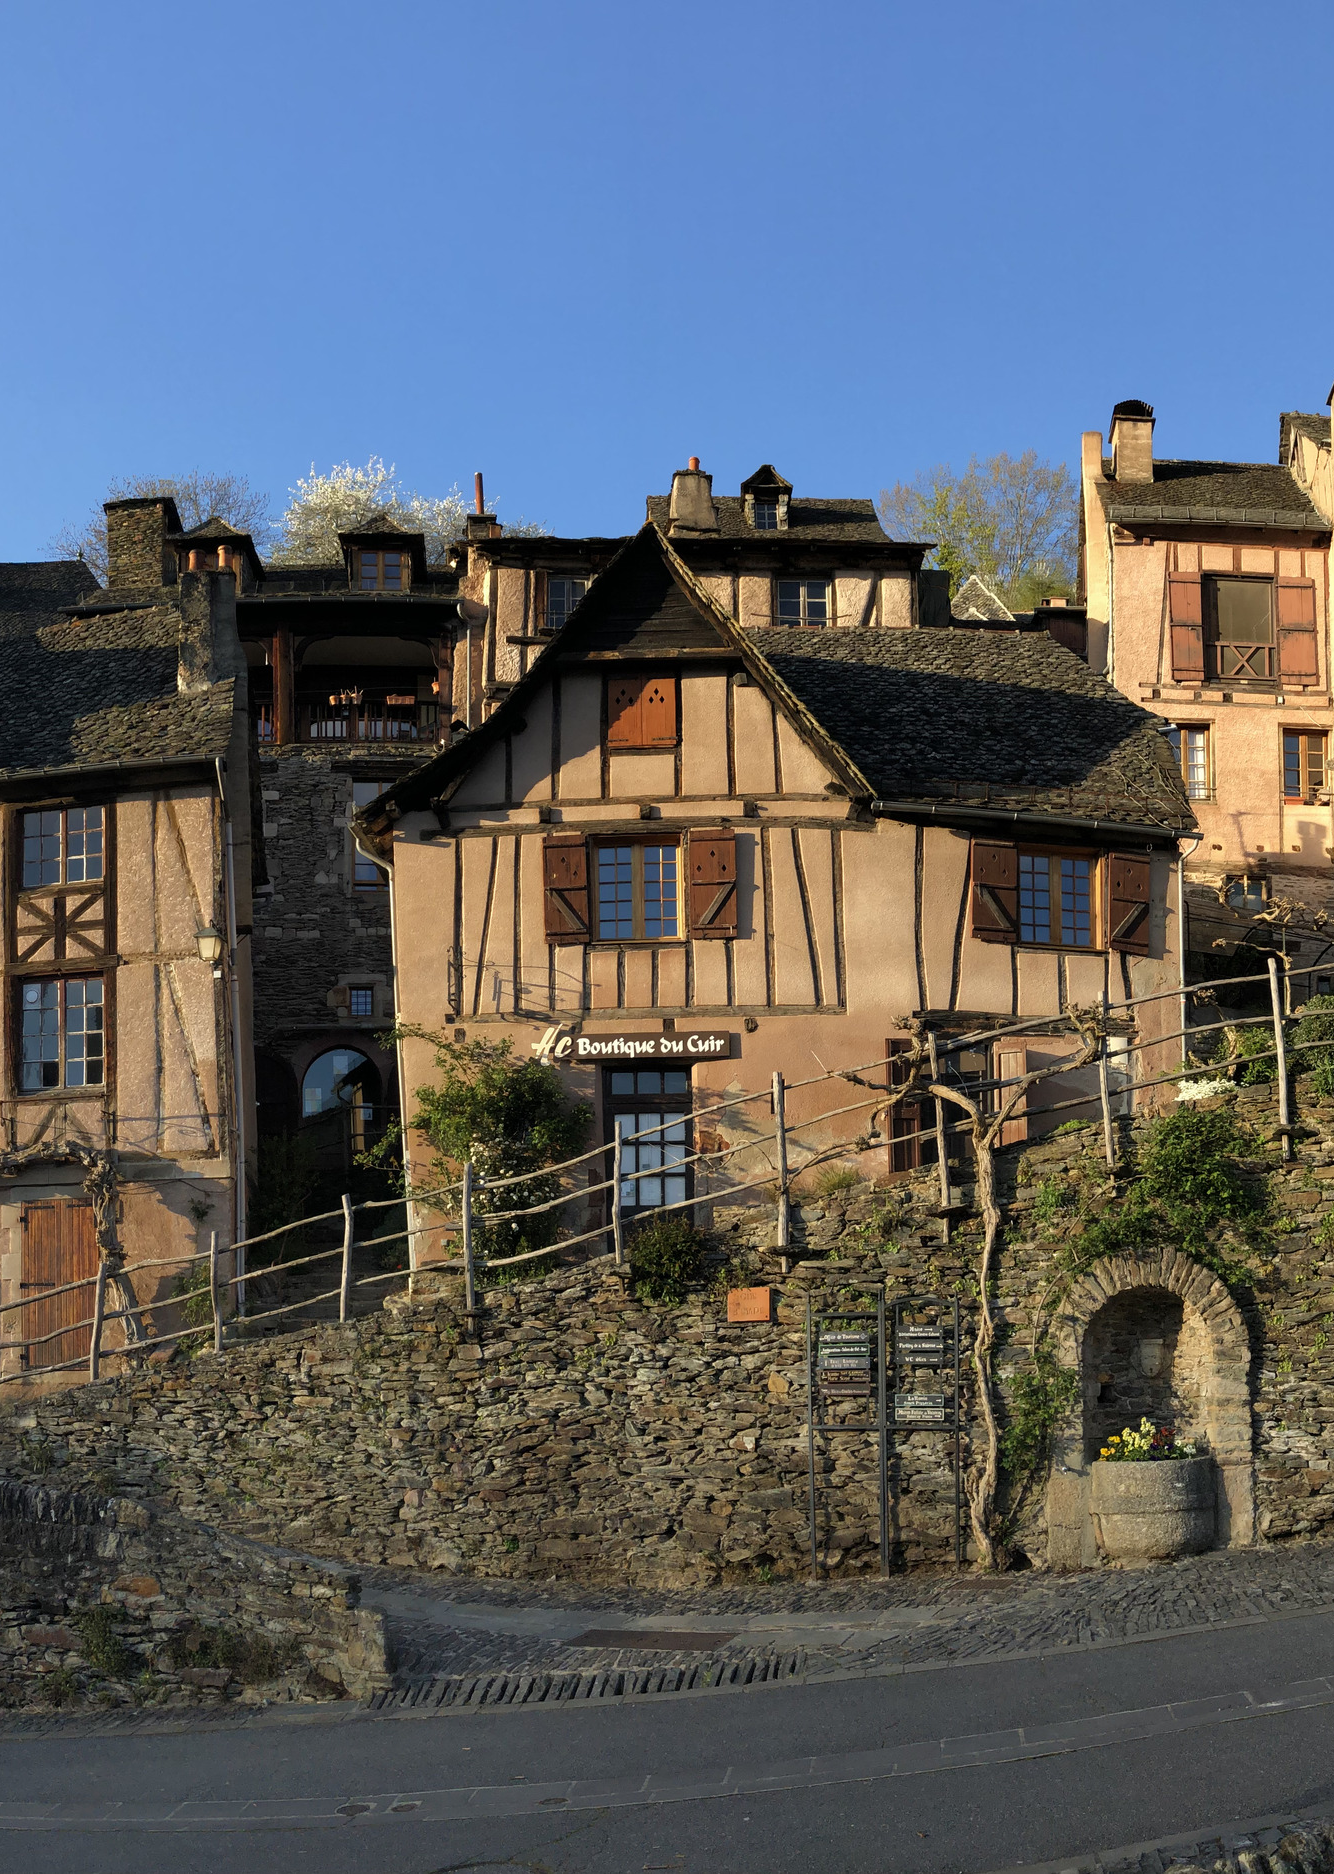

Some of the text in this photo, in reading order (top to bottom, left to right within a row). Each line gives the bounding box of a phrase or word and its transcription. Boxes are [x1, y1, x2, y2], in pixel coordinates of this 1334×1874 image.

[576, 1037, 655, 1058] Boutique
[661, 1037, 683, 1053] du
[687, 1035, 725, 1052] Cuir
